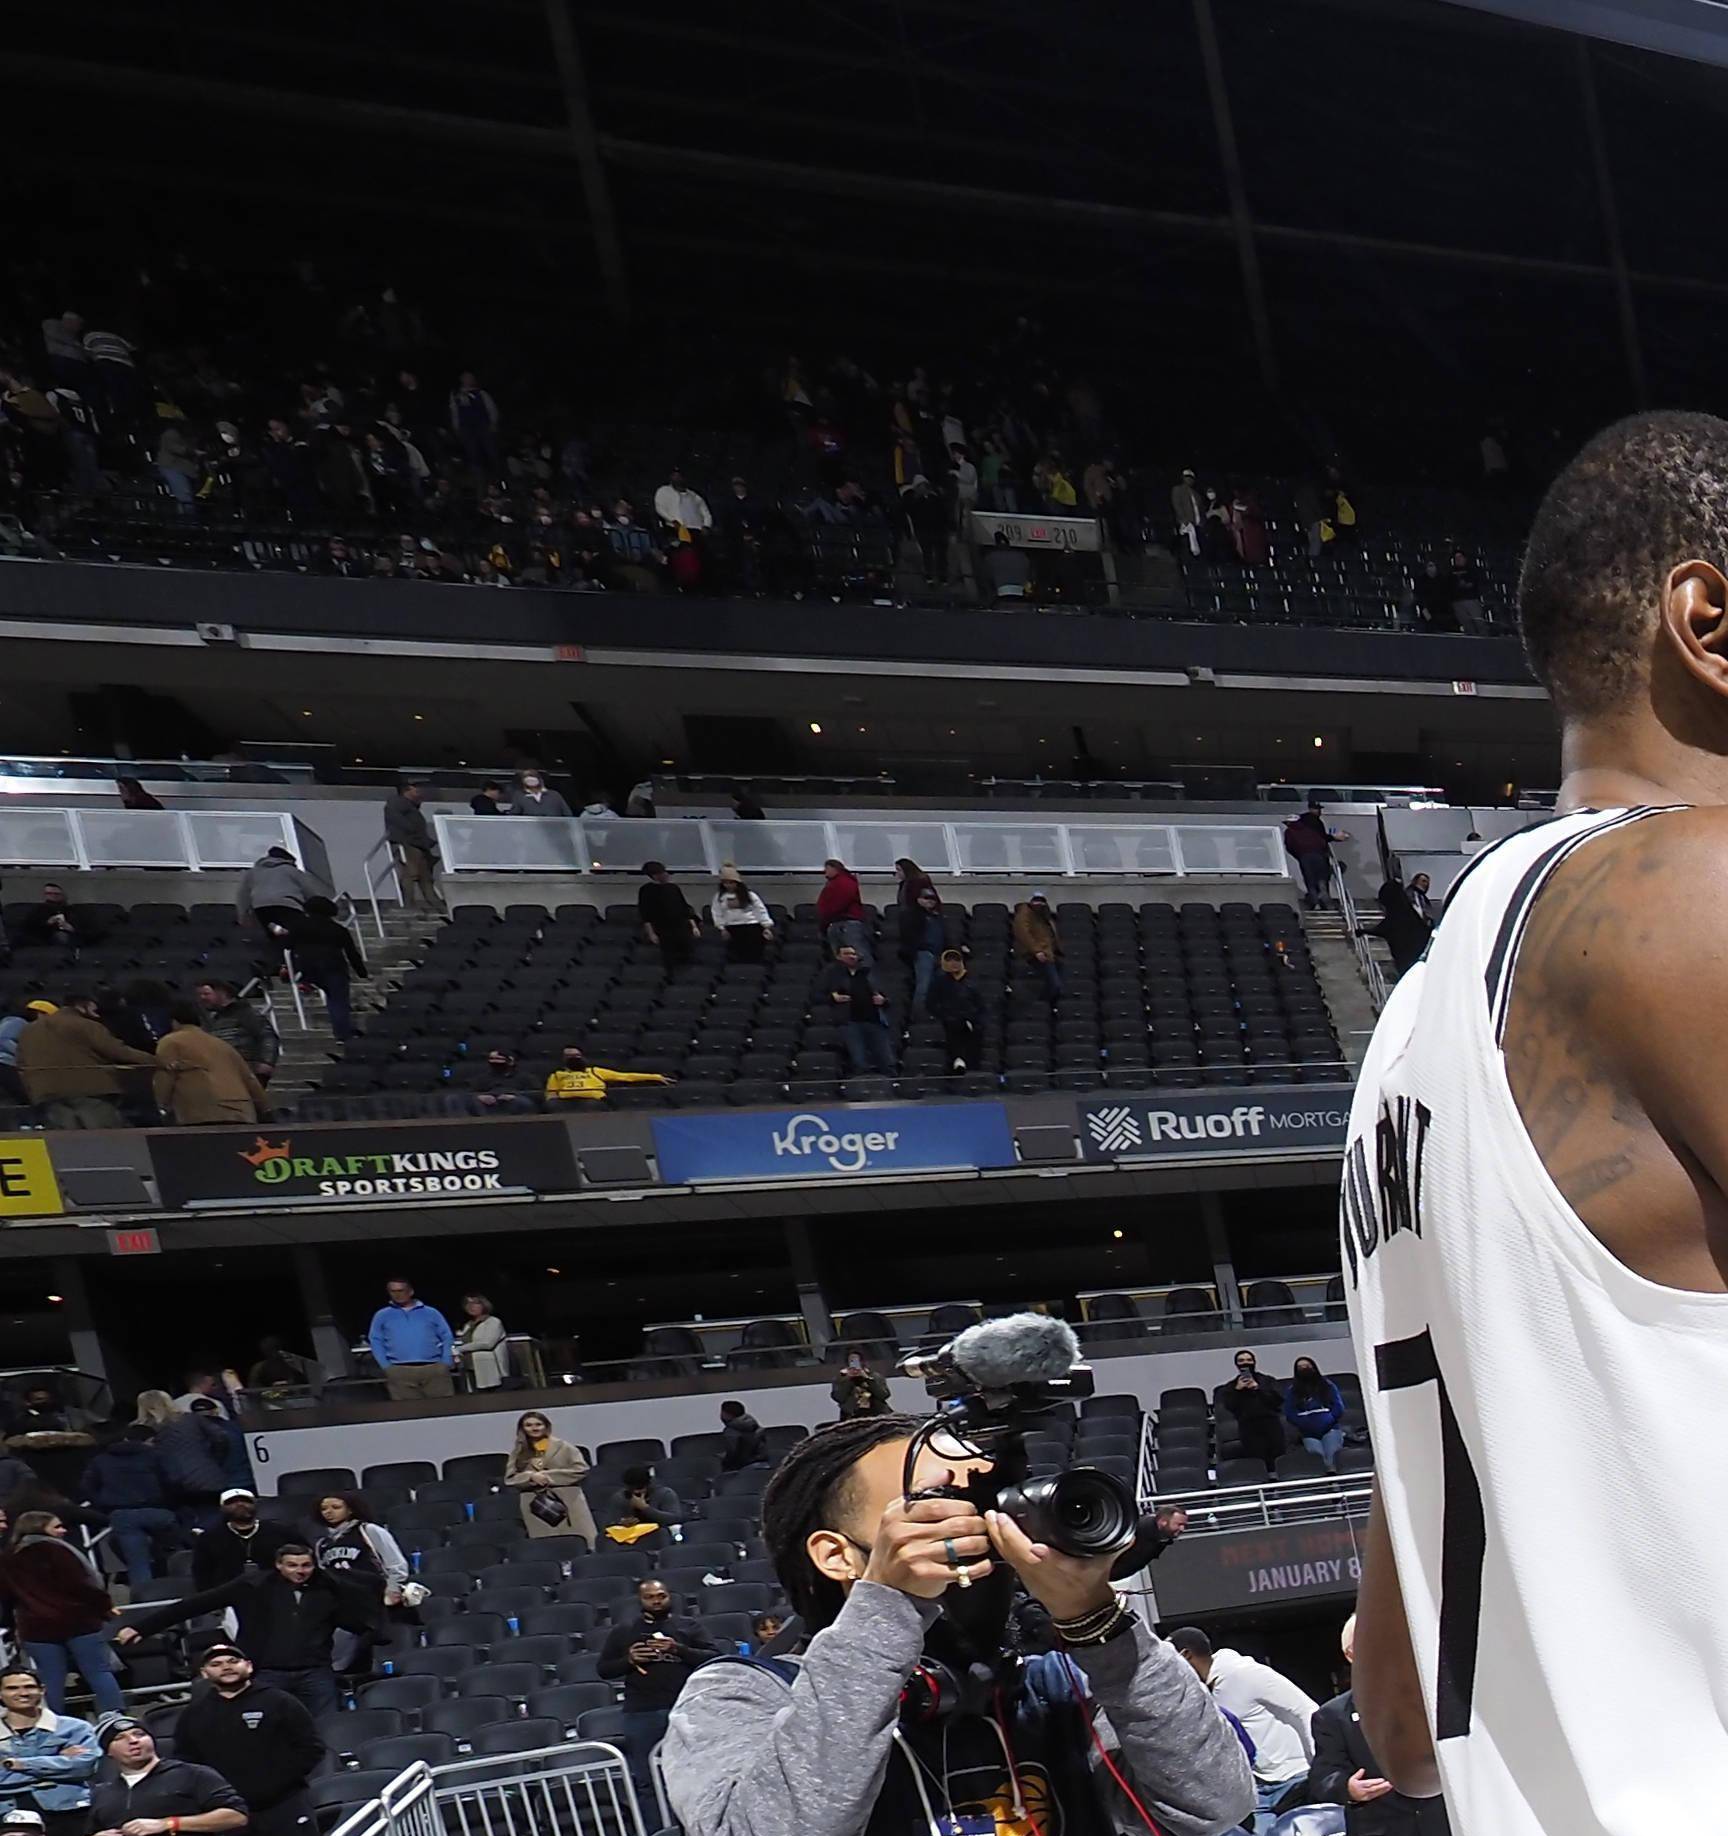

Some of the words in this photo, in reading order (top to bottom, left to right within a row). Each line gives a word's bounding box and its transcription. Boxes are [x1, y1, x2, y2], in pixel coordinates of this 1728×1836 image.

[1149, 1104, 1266, 1142] Ruoff
[773, 1113, 899, 1171] Kroger
[254, 1149, 500, 1185] DRAFTKINGS
[319, 1173, 502, 1198] SPORTSBOOK
[117, 1231, 152, 1253] EXIT
[254, 1436, 270, 1463] 6
[1248, 1561, 1341, 1593] JANUARY
